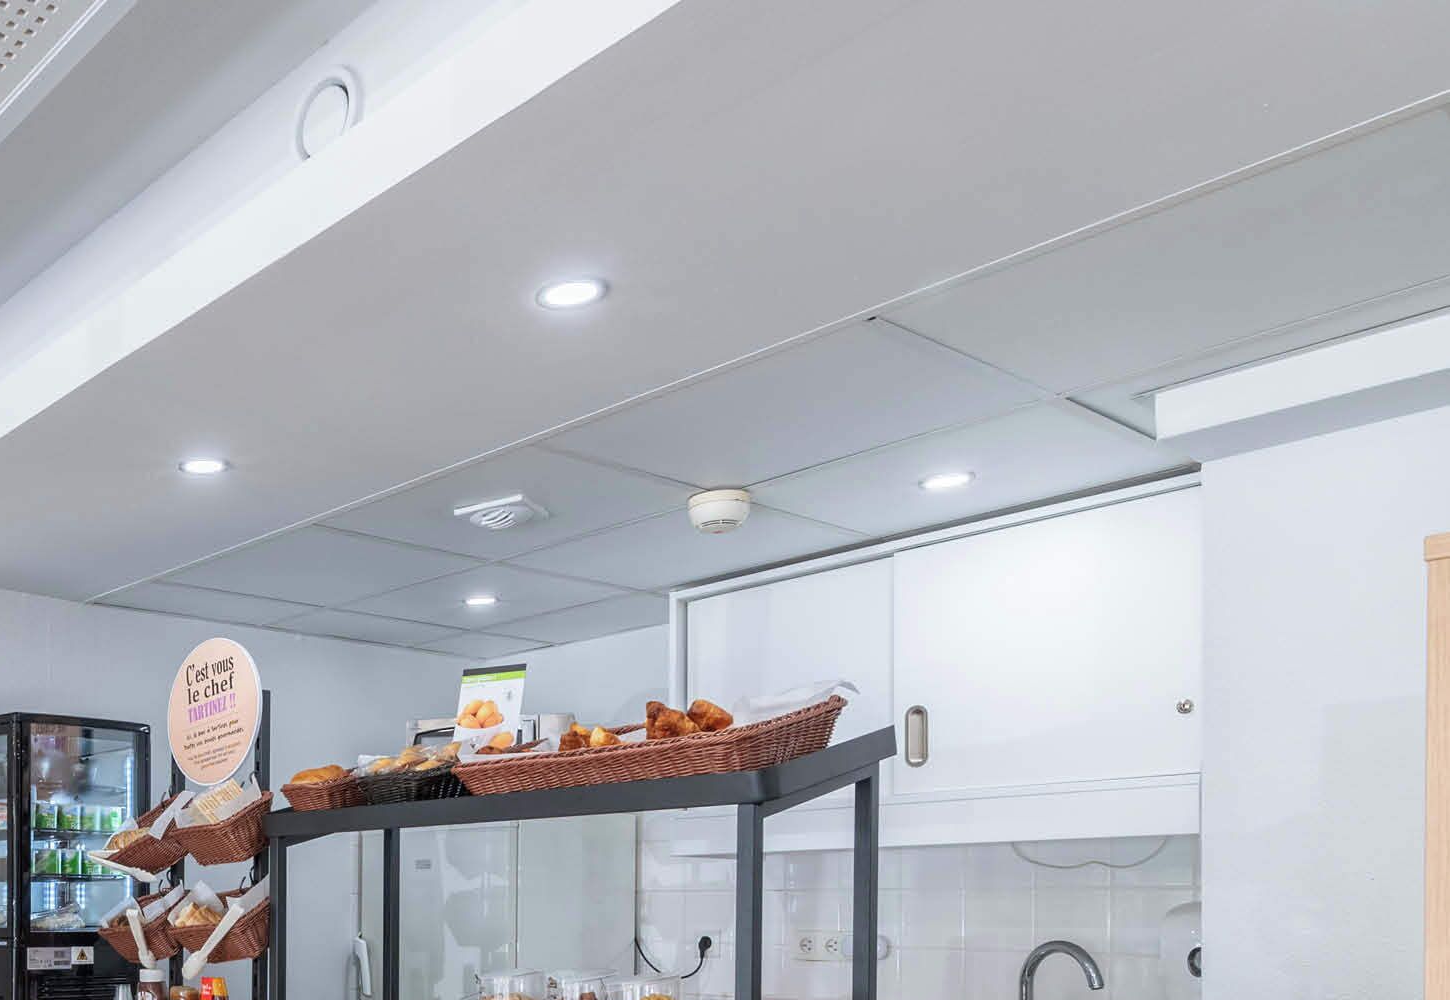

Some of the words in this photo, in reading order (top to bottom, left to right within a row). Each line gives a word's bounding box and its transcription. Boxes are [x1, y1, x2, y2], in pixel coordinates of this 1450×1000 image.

[186, 661, 209, 687] C'est
[211, 656, 234, 677] vous
[187, 688, 200, 705] le
[204, 671, 235, 699] chef
[188, 695, 227, 723] TARTINEZ
